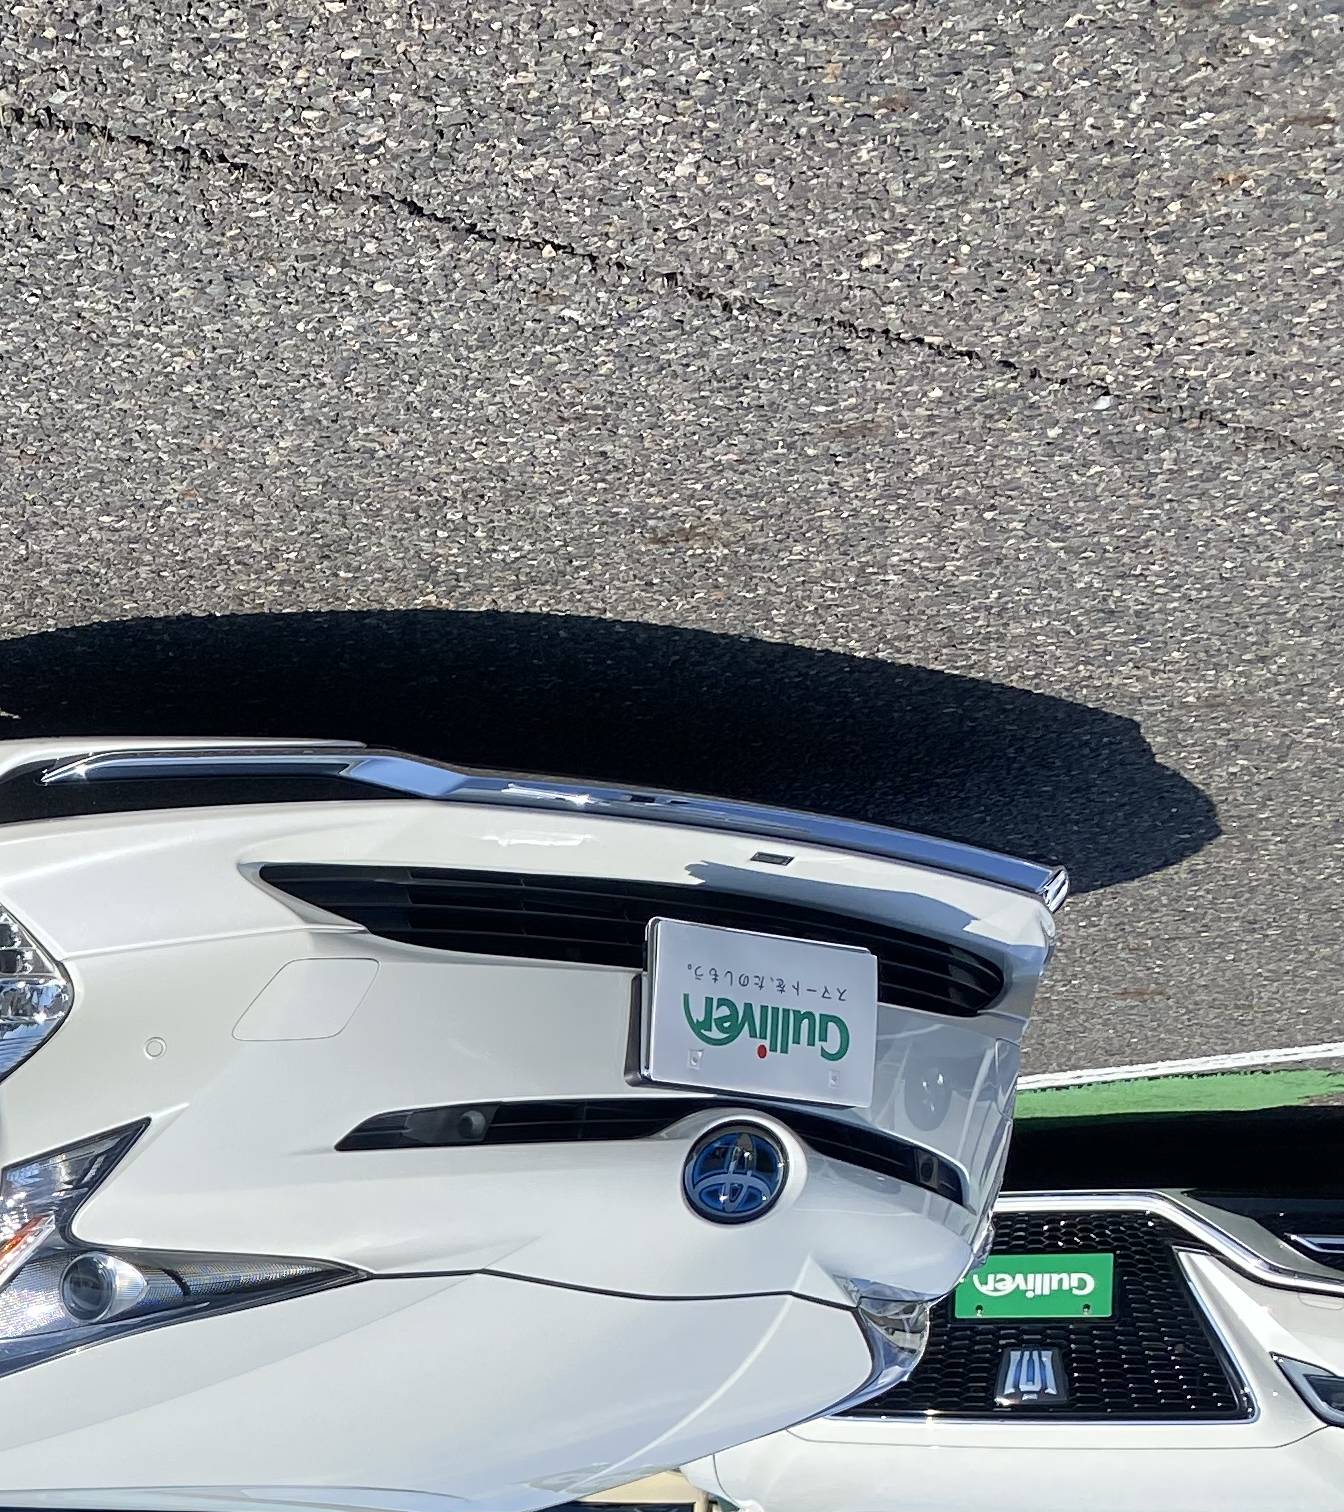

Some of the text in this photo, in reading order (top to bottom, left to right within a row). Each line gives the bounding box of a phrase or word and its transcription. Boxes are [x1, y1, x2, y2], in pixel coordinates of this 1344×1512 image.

[686, 963, 847, 1002] スマートを、たのしもう。
[682, 993, 850, 1062] Gulliver
[972, 1272, 1095, 1299] Gulliver
